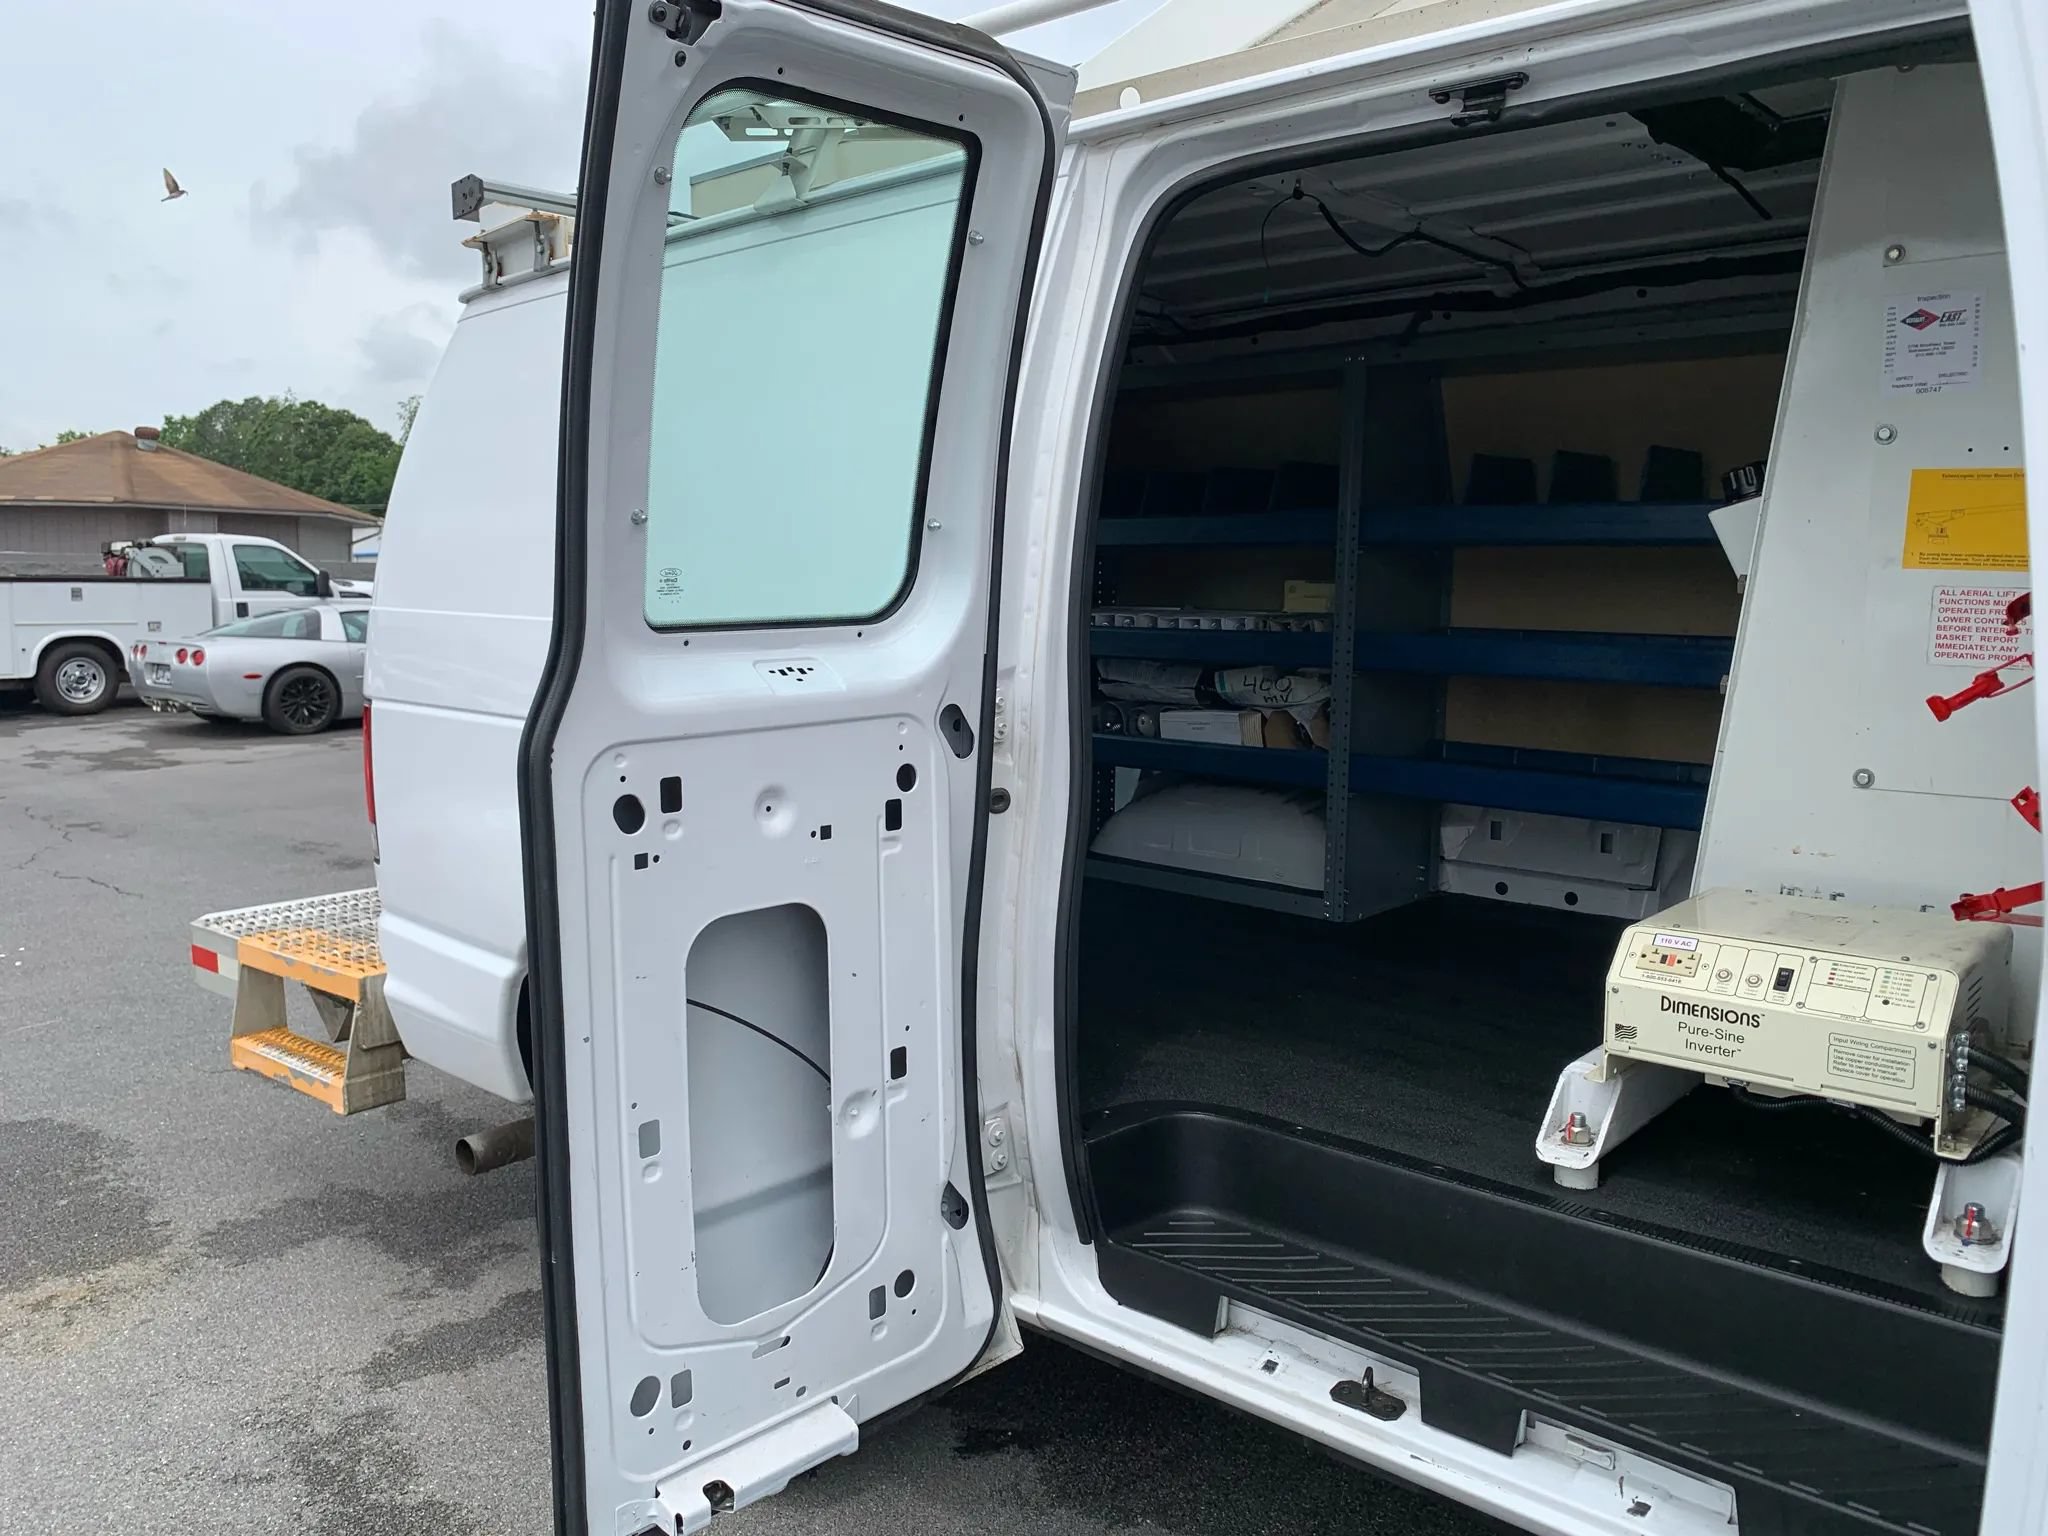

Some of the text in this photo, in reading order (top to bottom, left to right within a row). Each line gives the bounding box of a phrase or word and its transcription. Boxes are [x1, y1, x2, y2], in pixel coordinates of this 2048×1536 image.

[1940, 309, 1967, 322] EAST
[1939, 598, 2012, 607] FUNCTIONS MU
[1938, 607, 2008, 616] OPERATED FRO
[1937, 616, 1971, 624] LOWER
[1936, 625, 1973, 633] BEFORE
[1980, 635, 2019, 643] REPORT
[1935, 643, 2019, 653] IMMEDIATELY ANY
[1934, 651, 1986, 660] OPERATING
[1243, 675, 1292, 694] 400
[1678, 1021, 1745, 1044] Pure-Sine
[1685, 1038, 1736, 1058] Inverter
[1833, 1036, 1912, 1055] Input Wiring Compartment
